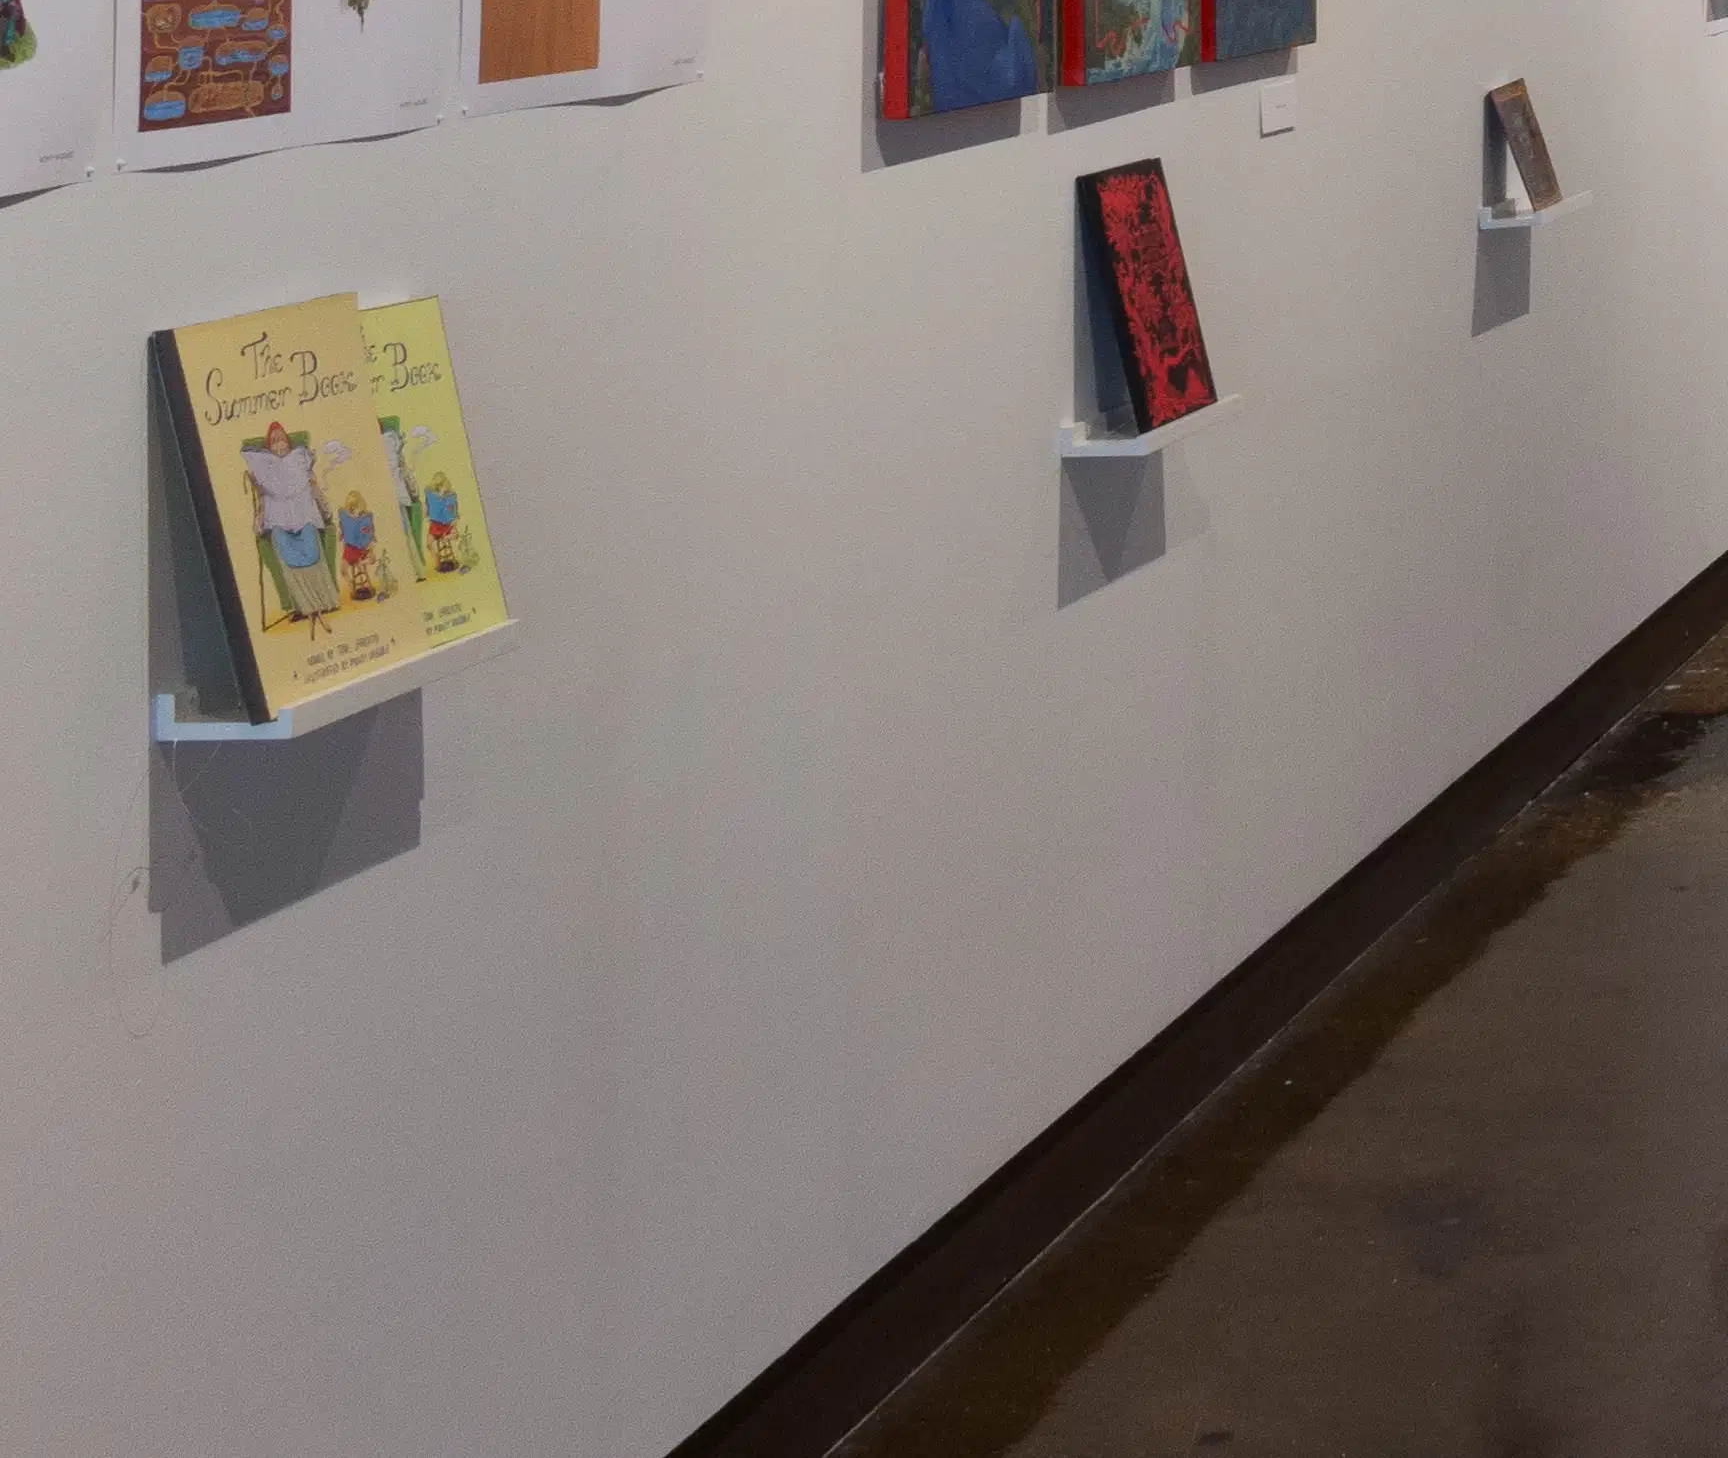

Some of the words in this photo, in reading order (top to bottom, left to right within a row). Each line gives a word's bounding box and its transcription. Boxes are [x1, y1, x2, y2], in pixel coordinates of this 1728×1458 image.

[241, 331, 283, 379] The
[204, 367, 293, 427] Summer
[289, 349, 358, 405] Book
